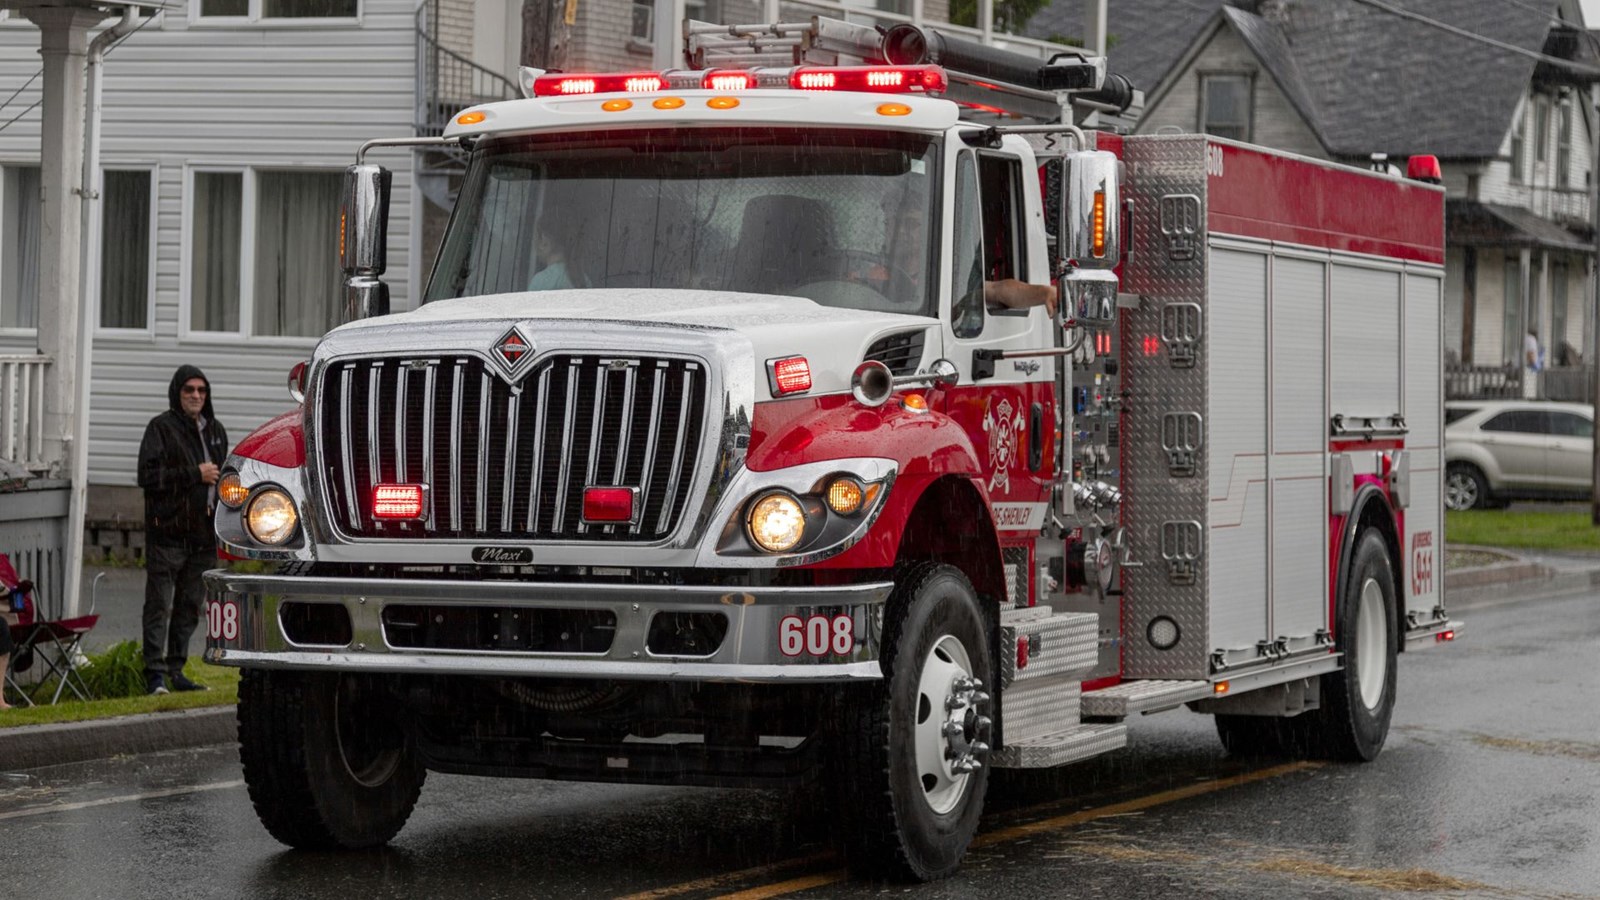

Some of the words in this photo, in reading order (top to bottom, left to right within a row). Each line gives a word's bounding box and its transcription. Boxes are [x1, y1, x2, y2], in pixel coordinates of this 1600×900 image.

[1207, 144, 1224, 178] 608
[480, 547, 524, 561] Maxi
[205, 601, 238, 640] 08
[779, 614, 853, 657] 608
